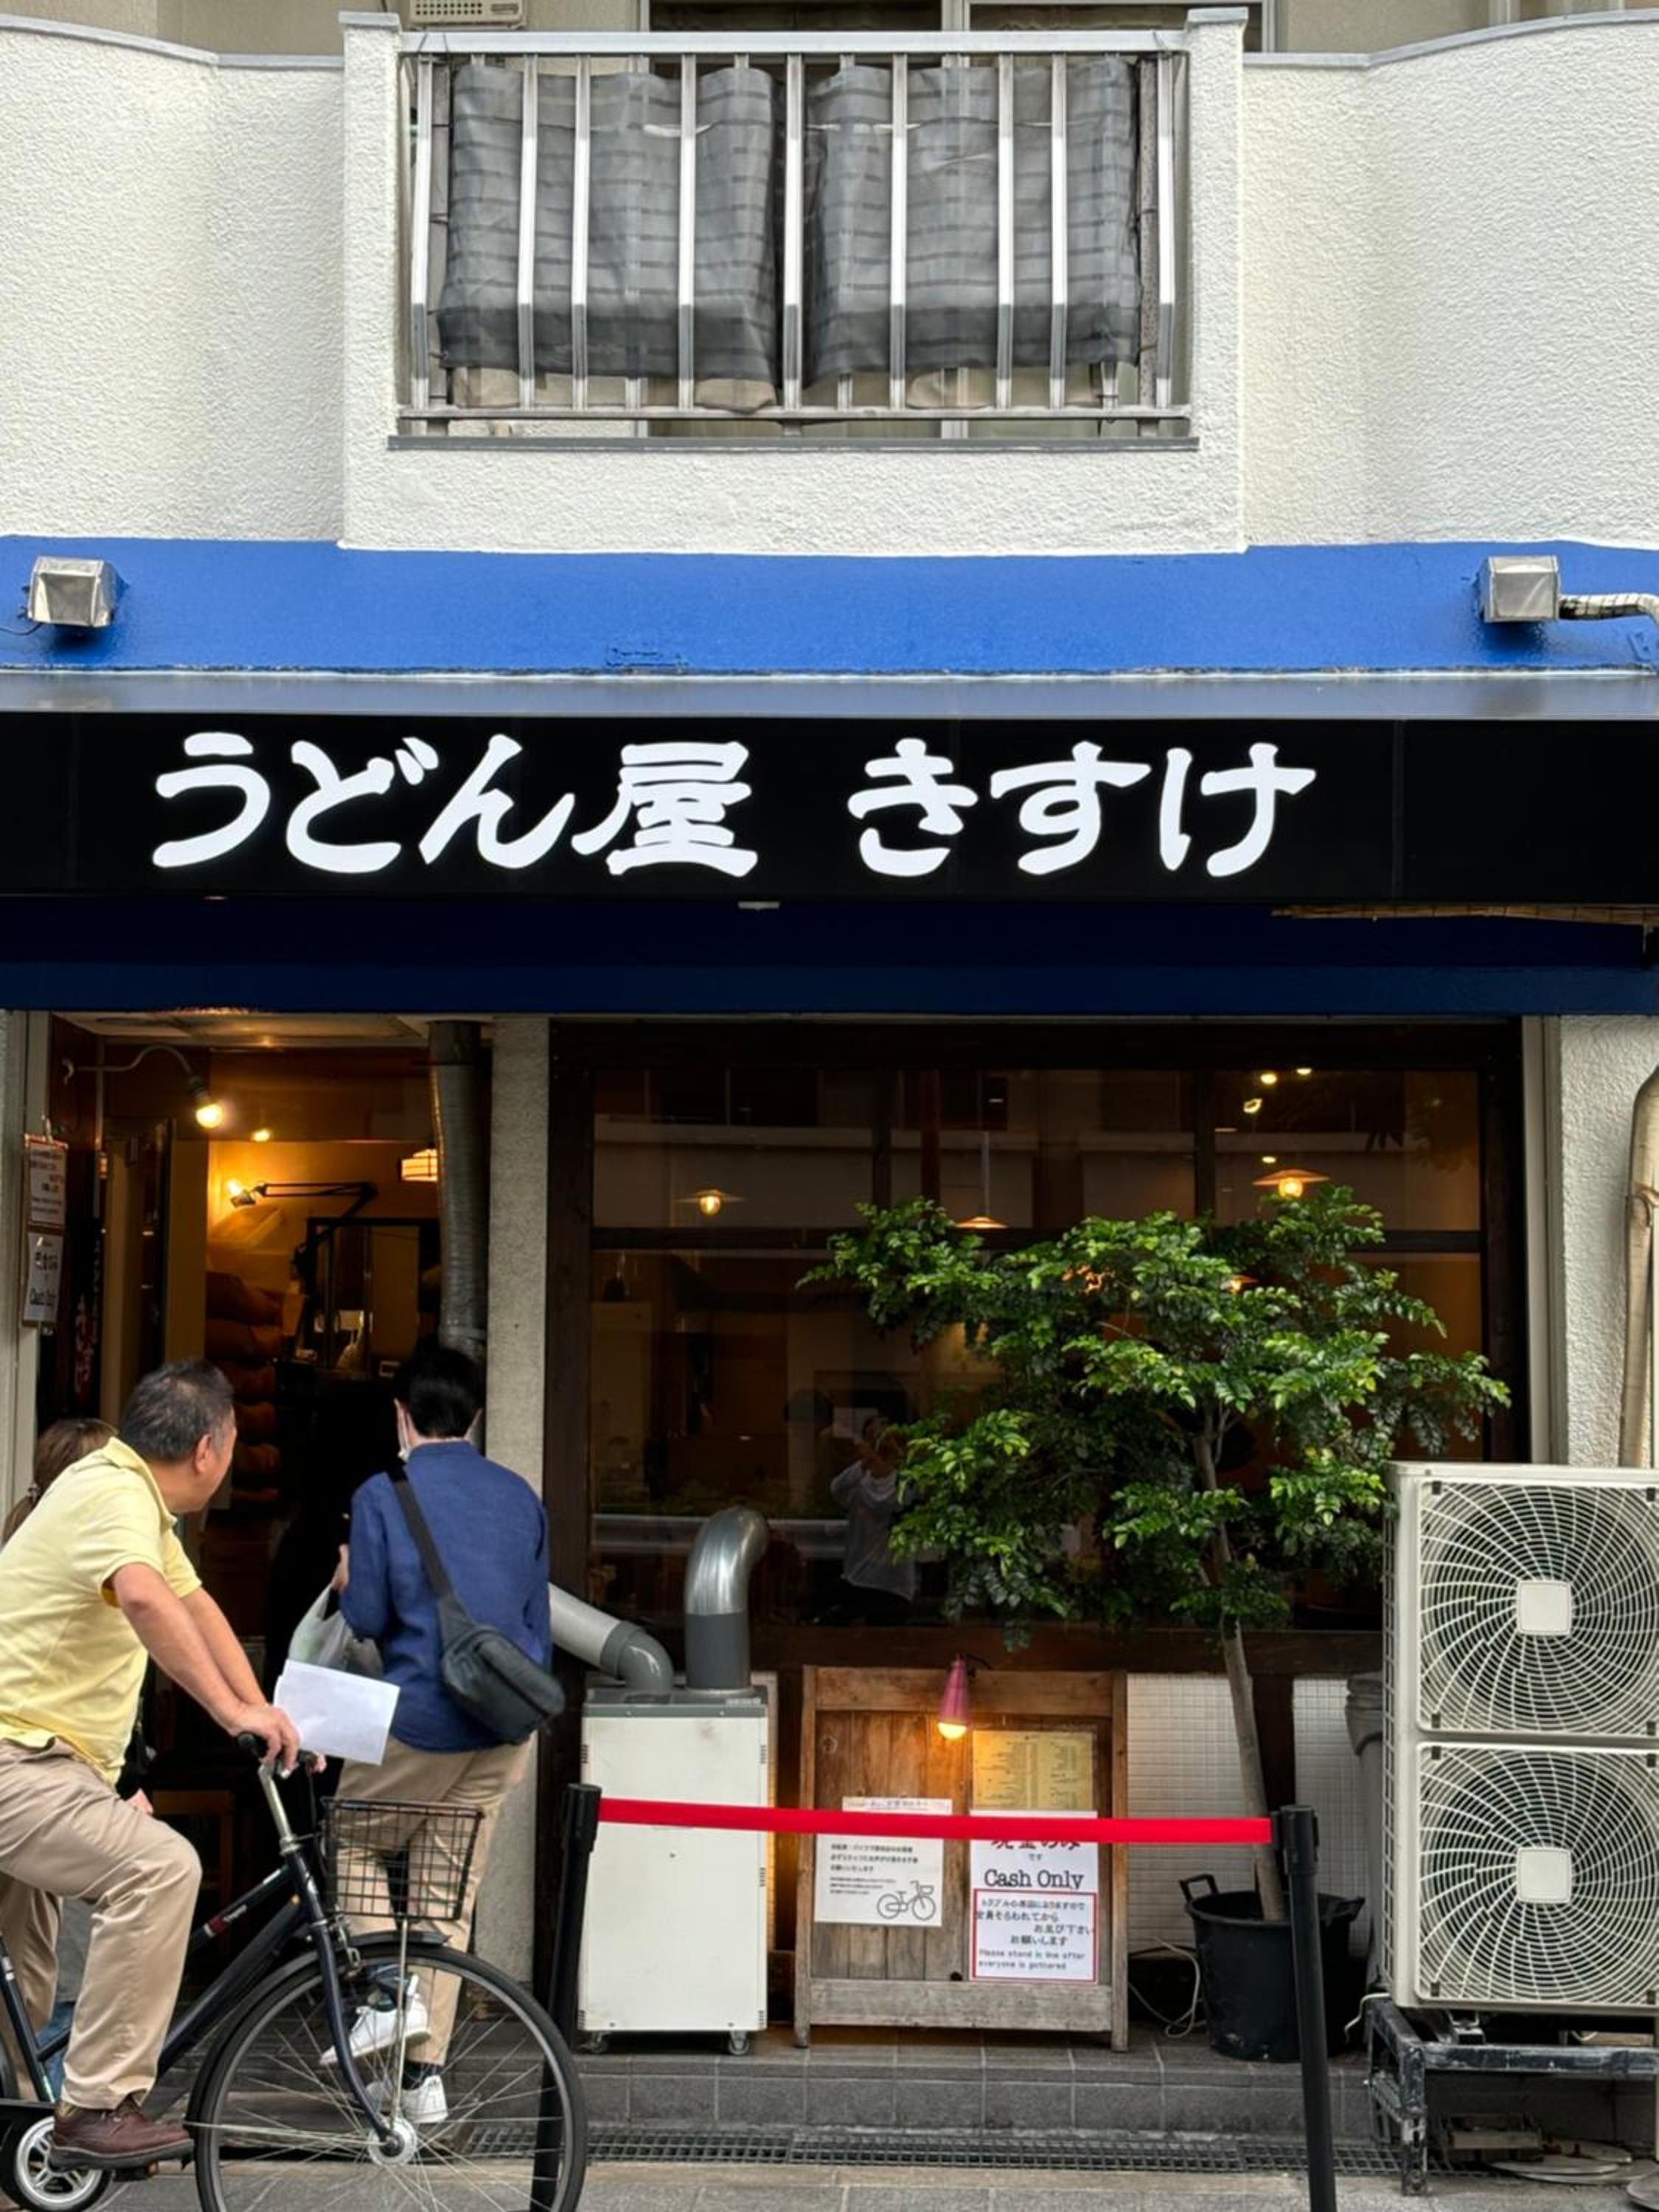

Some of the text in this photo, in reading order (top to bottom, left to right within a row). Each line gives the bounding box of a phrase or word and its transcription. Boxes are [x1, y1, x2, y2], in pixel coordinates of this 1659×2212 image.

[151, 731, 1316, 877] うどん屋 きすけ
[984, 1868, 1085, 1889] Cash Only
[1010, 1935, 1068, 1946] お願いします
